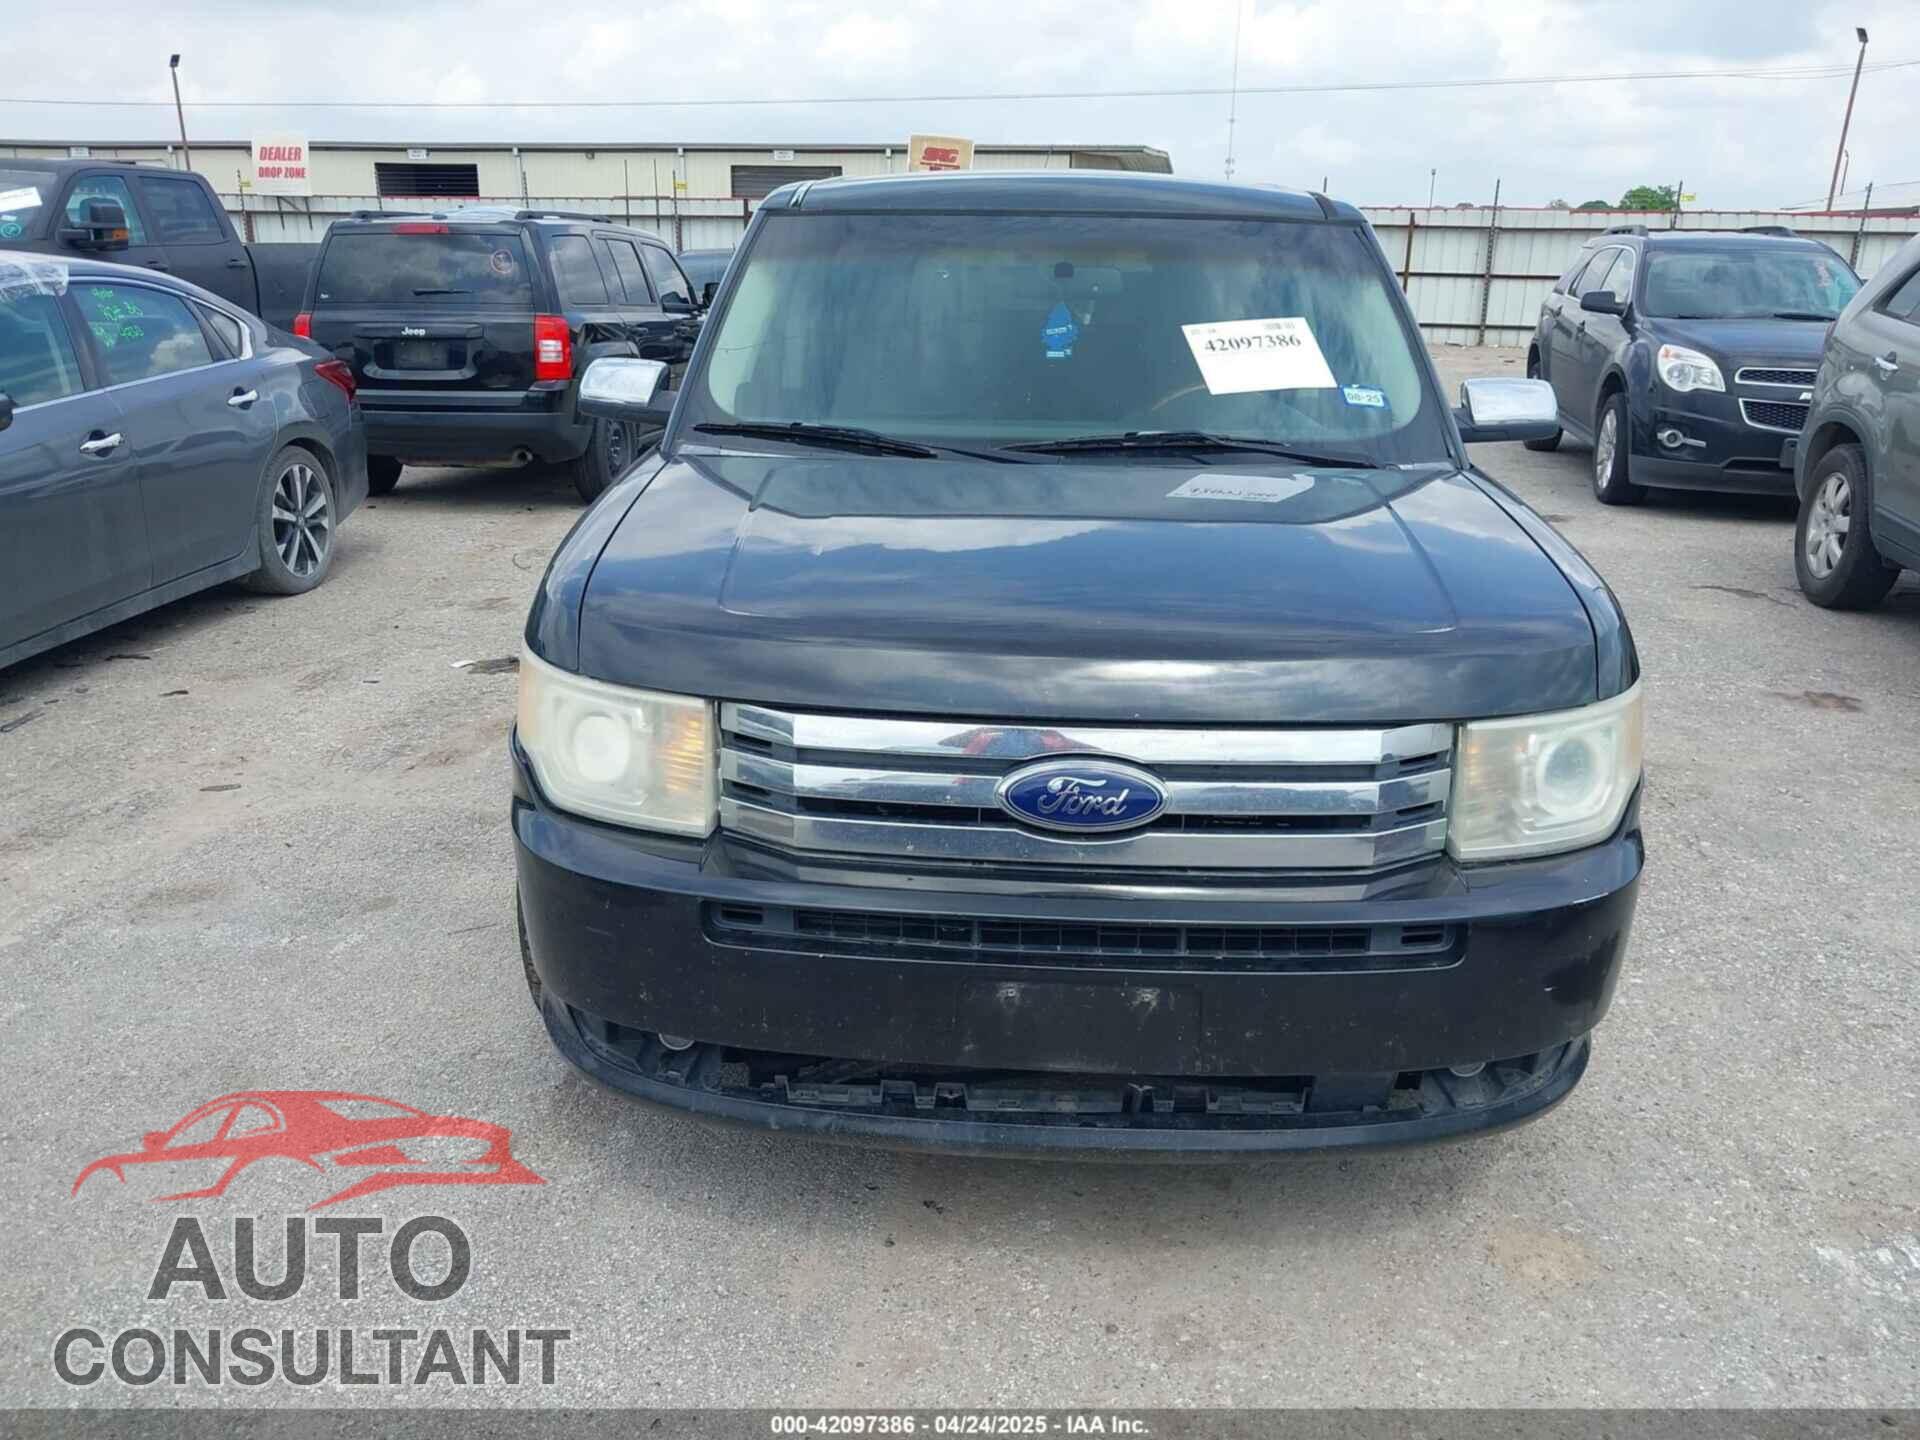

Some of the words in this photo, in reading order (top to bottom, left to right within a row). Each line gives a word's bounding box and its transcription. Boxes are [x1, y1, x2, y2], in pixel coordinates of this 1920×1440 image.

[260, 146, 302, 161] DEALER
[258, 166, 282, 178] DROP
[284, 166, 306, 178] ZONE
[401, 326, 426, 336] Jeep
[1204, 334, 1302, 352] 42097386
[1037, 776, 1130, 816] Ford
